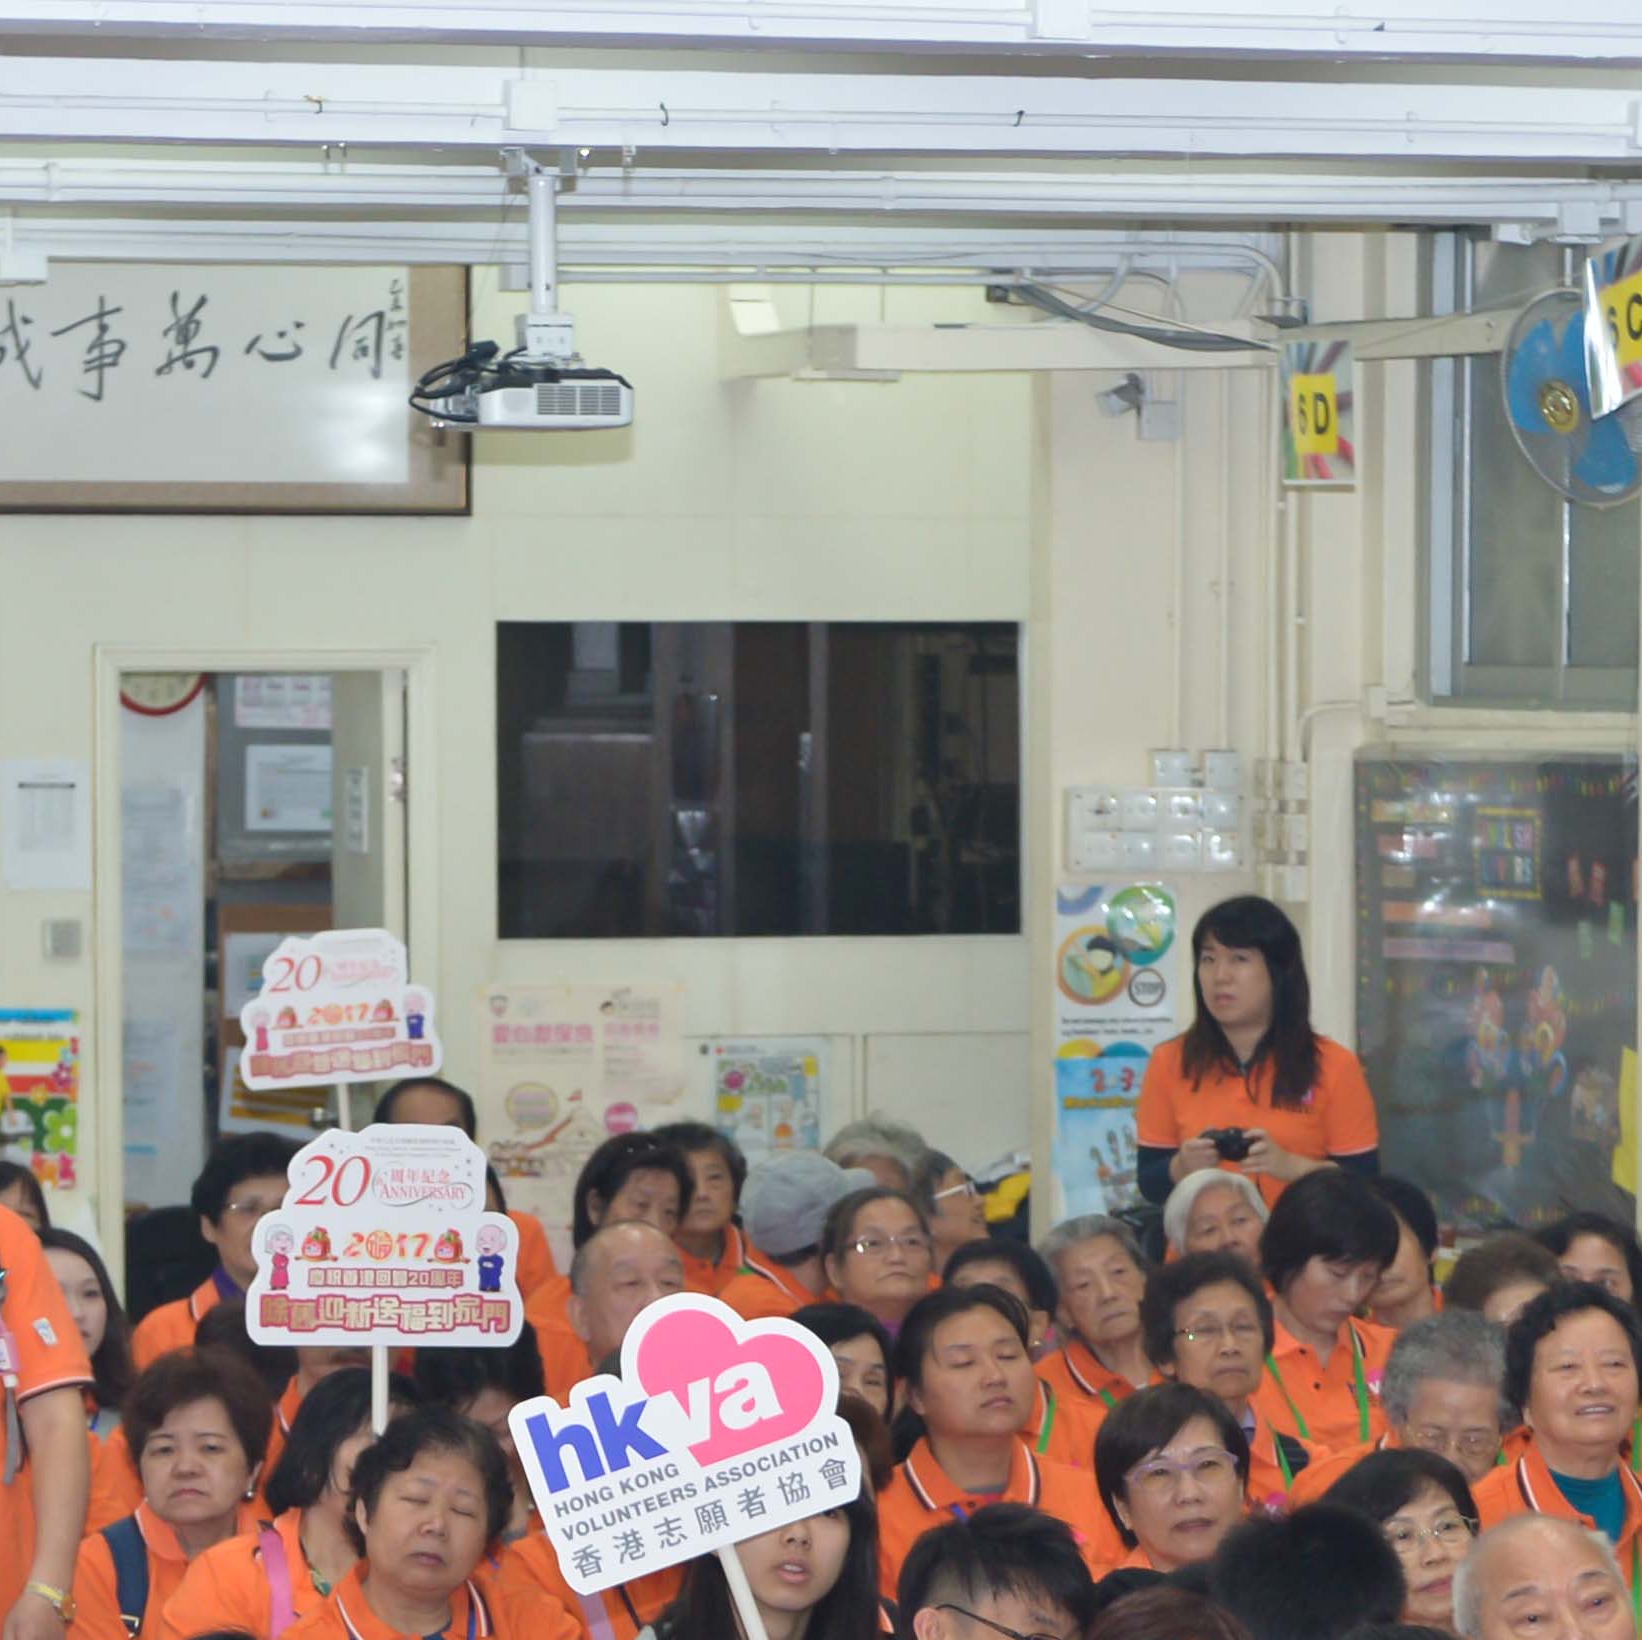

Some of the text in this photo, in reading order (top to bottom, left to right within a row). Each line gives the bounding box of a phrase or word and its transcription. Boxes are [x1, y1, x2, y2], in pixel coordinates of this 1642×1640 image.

[269, 955, 323, 993] 20
[295, 1155, 372, 1207] 20
[379, 1184, 467, 1201] ANNIVERSARY
[525, 1361, 784, 1494] hkva
[553, 1462, 680, 1519] HONG KONG
[561, 1430, 840, 1542] VOLUNTEERS ASSOCIATION
[572, 1456, 849, 1579] 香港志願者協會
